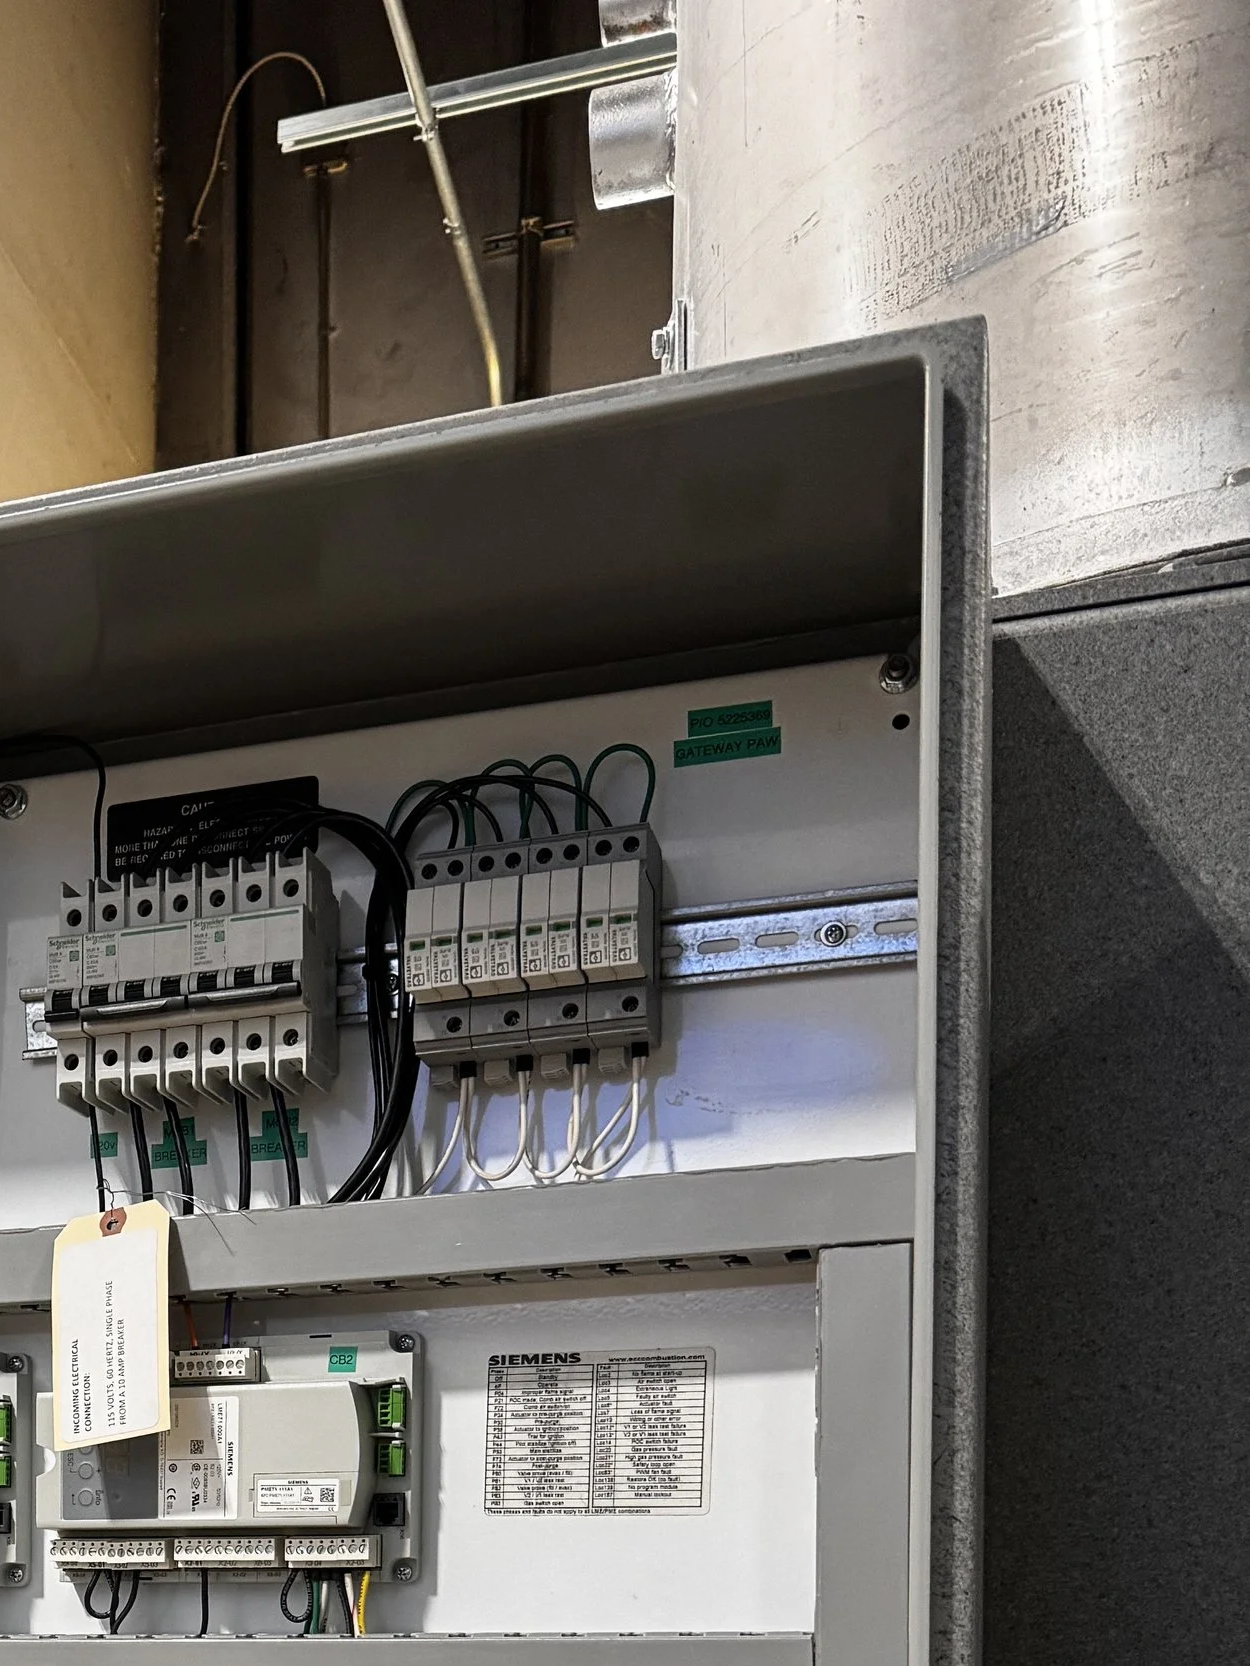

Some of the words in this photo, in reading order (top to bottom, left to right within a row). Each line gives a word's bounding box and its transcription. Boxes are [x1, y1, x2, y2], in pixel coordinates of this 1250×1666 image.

[690, 717, 712, 729] P/O
[675, 742, 742, 759] GATEWAY
[747, 736, 779, 749] PAW
[115, 857, 127, 866] BE
[193, 919, 225, 928] Schneider
[85, 933, 116, 943] Schneider
[49, 940, 79, 949] Schneider
[105, 1280, 113, 1306] PHASE
[106, 1309, 114, 1338] SINGLE
[117, 1319, 125, 1357] BREAKER
[106, 1339, 114, 1367] HERTZ,
[329, 1353, 354, 1365] CB2
[489, 1353, 581, 1365] SIEMENS
[107, 1368, 114, 1378] 60
[118, 1379, 126, 1389] 10
[107, 1380, 115, 1411] VOLTS,
[119, 1391, 125, 1399] A
[84, 1372, 92, 1432] CONNECTION:
